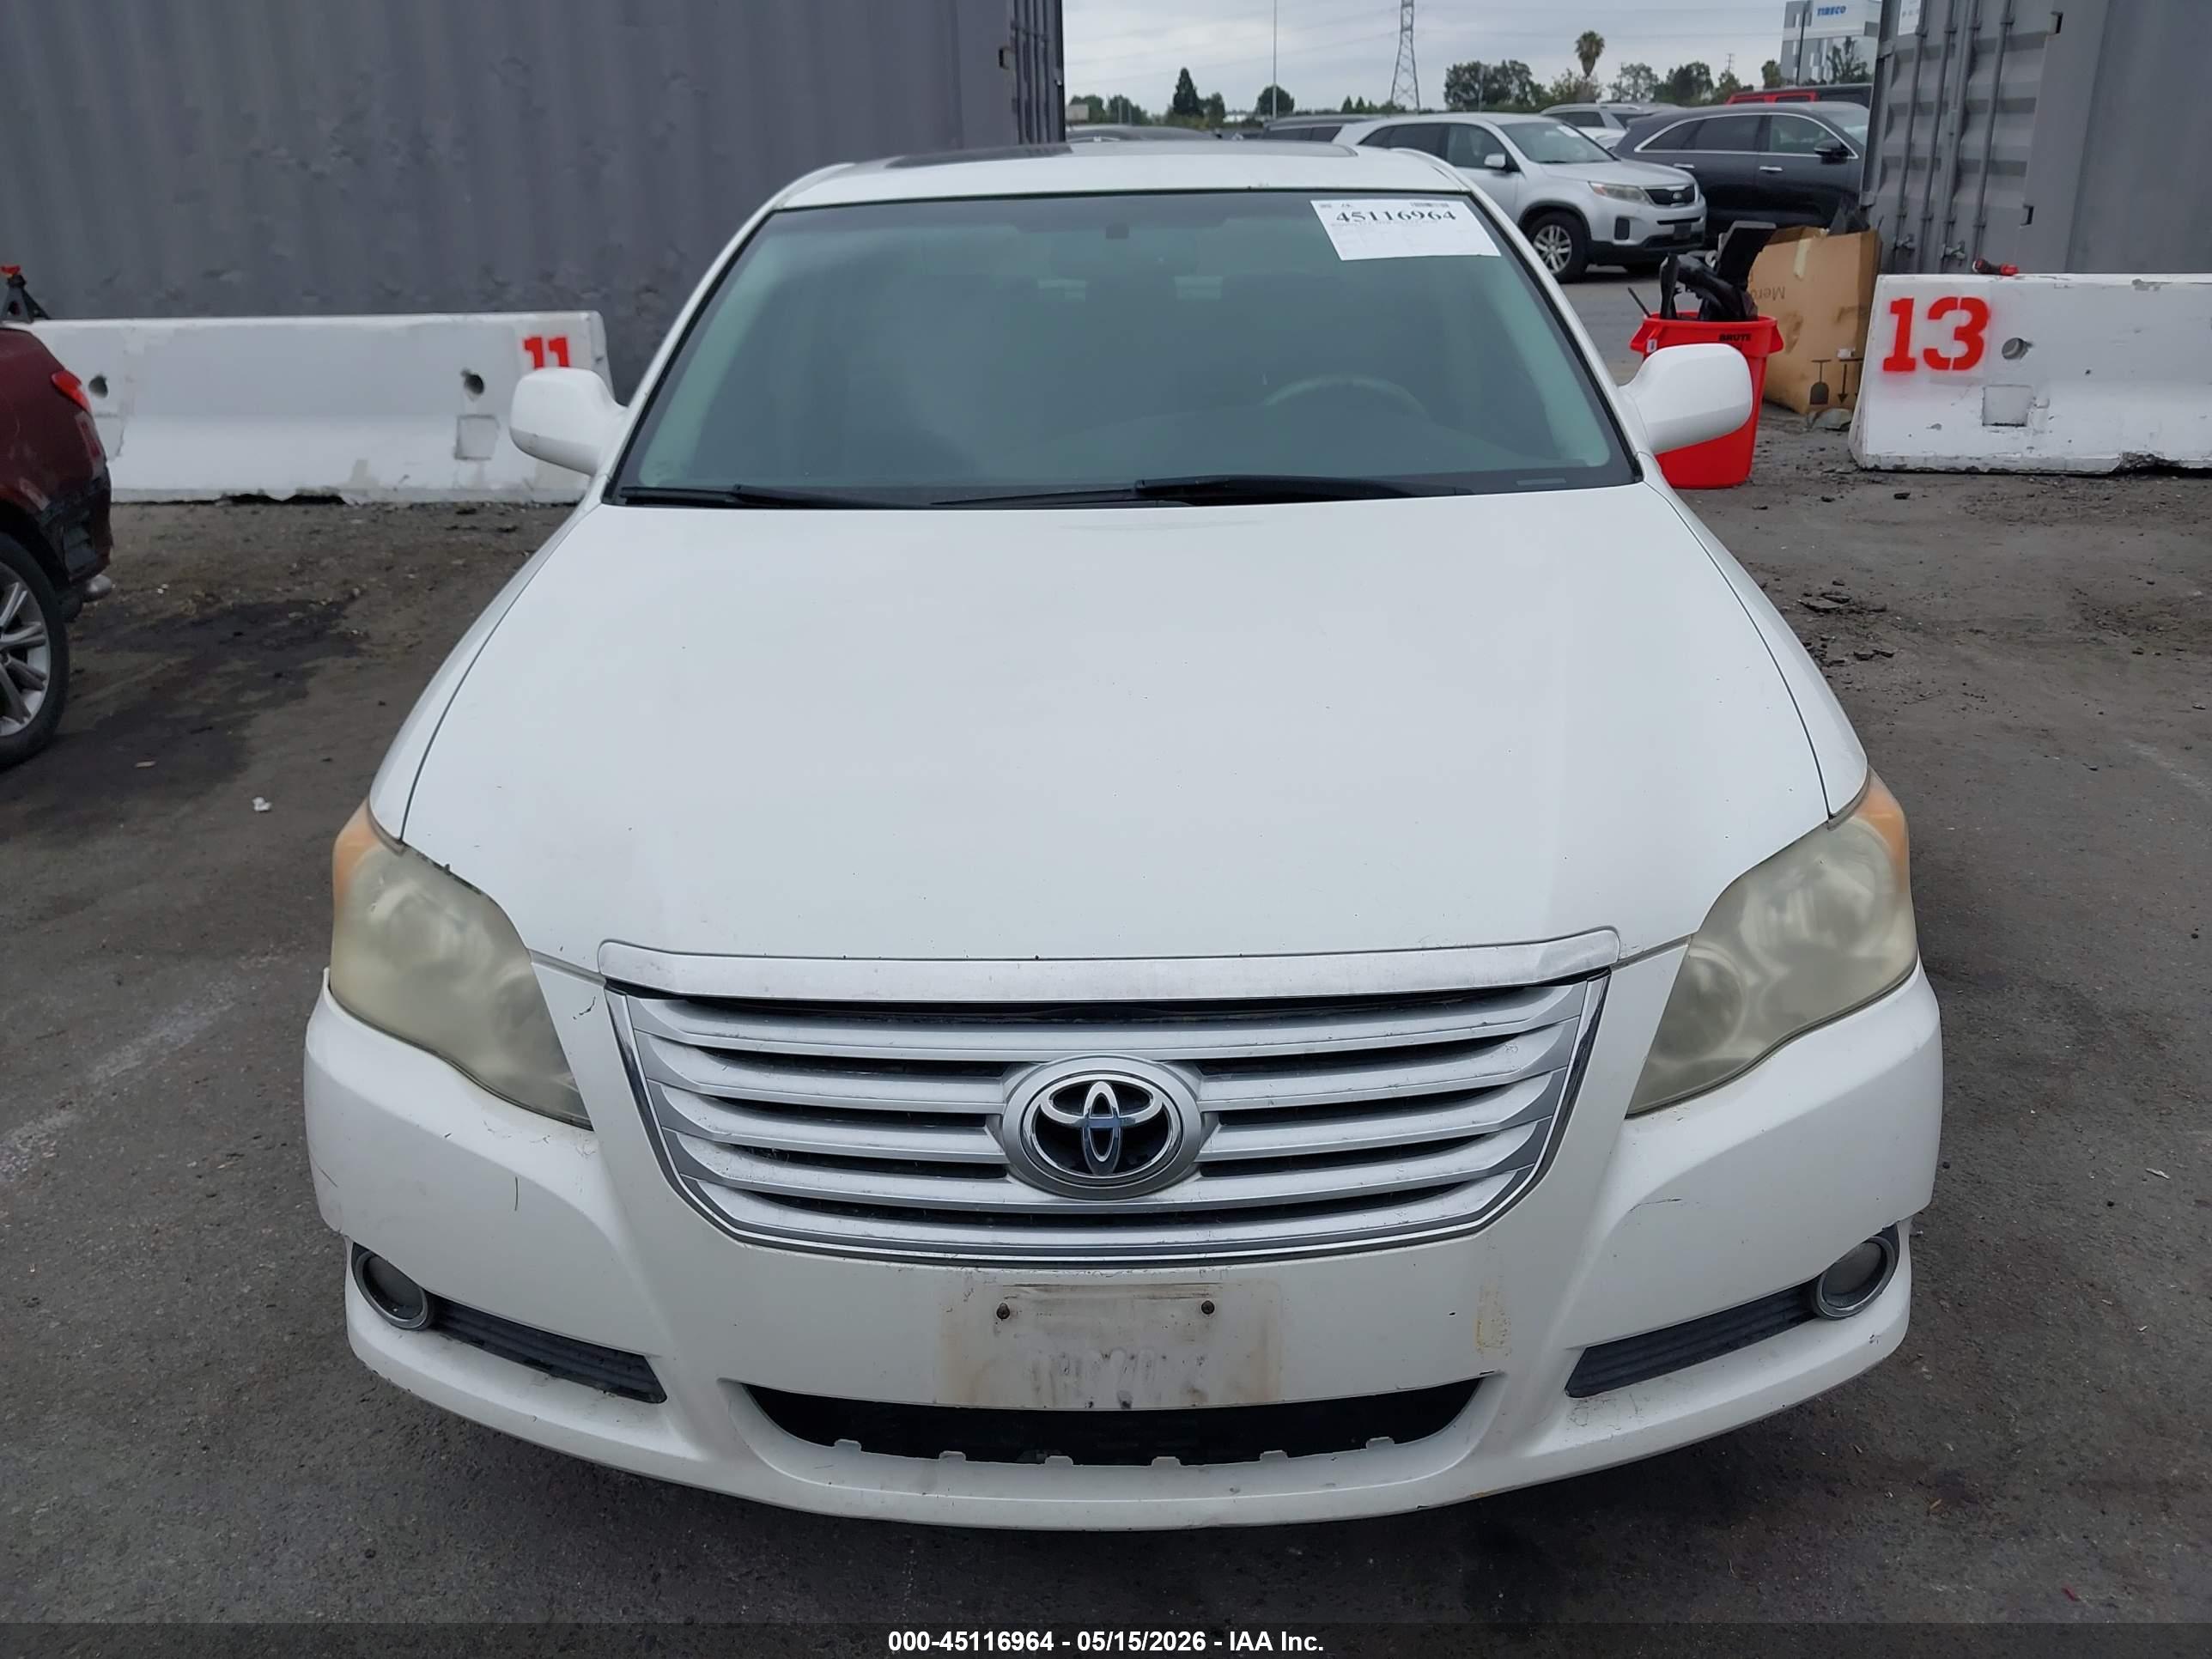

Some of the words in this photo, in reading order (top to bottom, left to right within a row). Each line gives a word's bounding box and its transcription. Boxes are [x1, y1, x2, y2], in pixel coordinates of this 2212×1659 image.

[1336, 210, 1457, 222] 45116964
[1719, 333, 1752, 342] BRUTE
[1883, 296, 1990, 372] 13
[524, 337, 570, 369] 11
